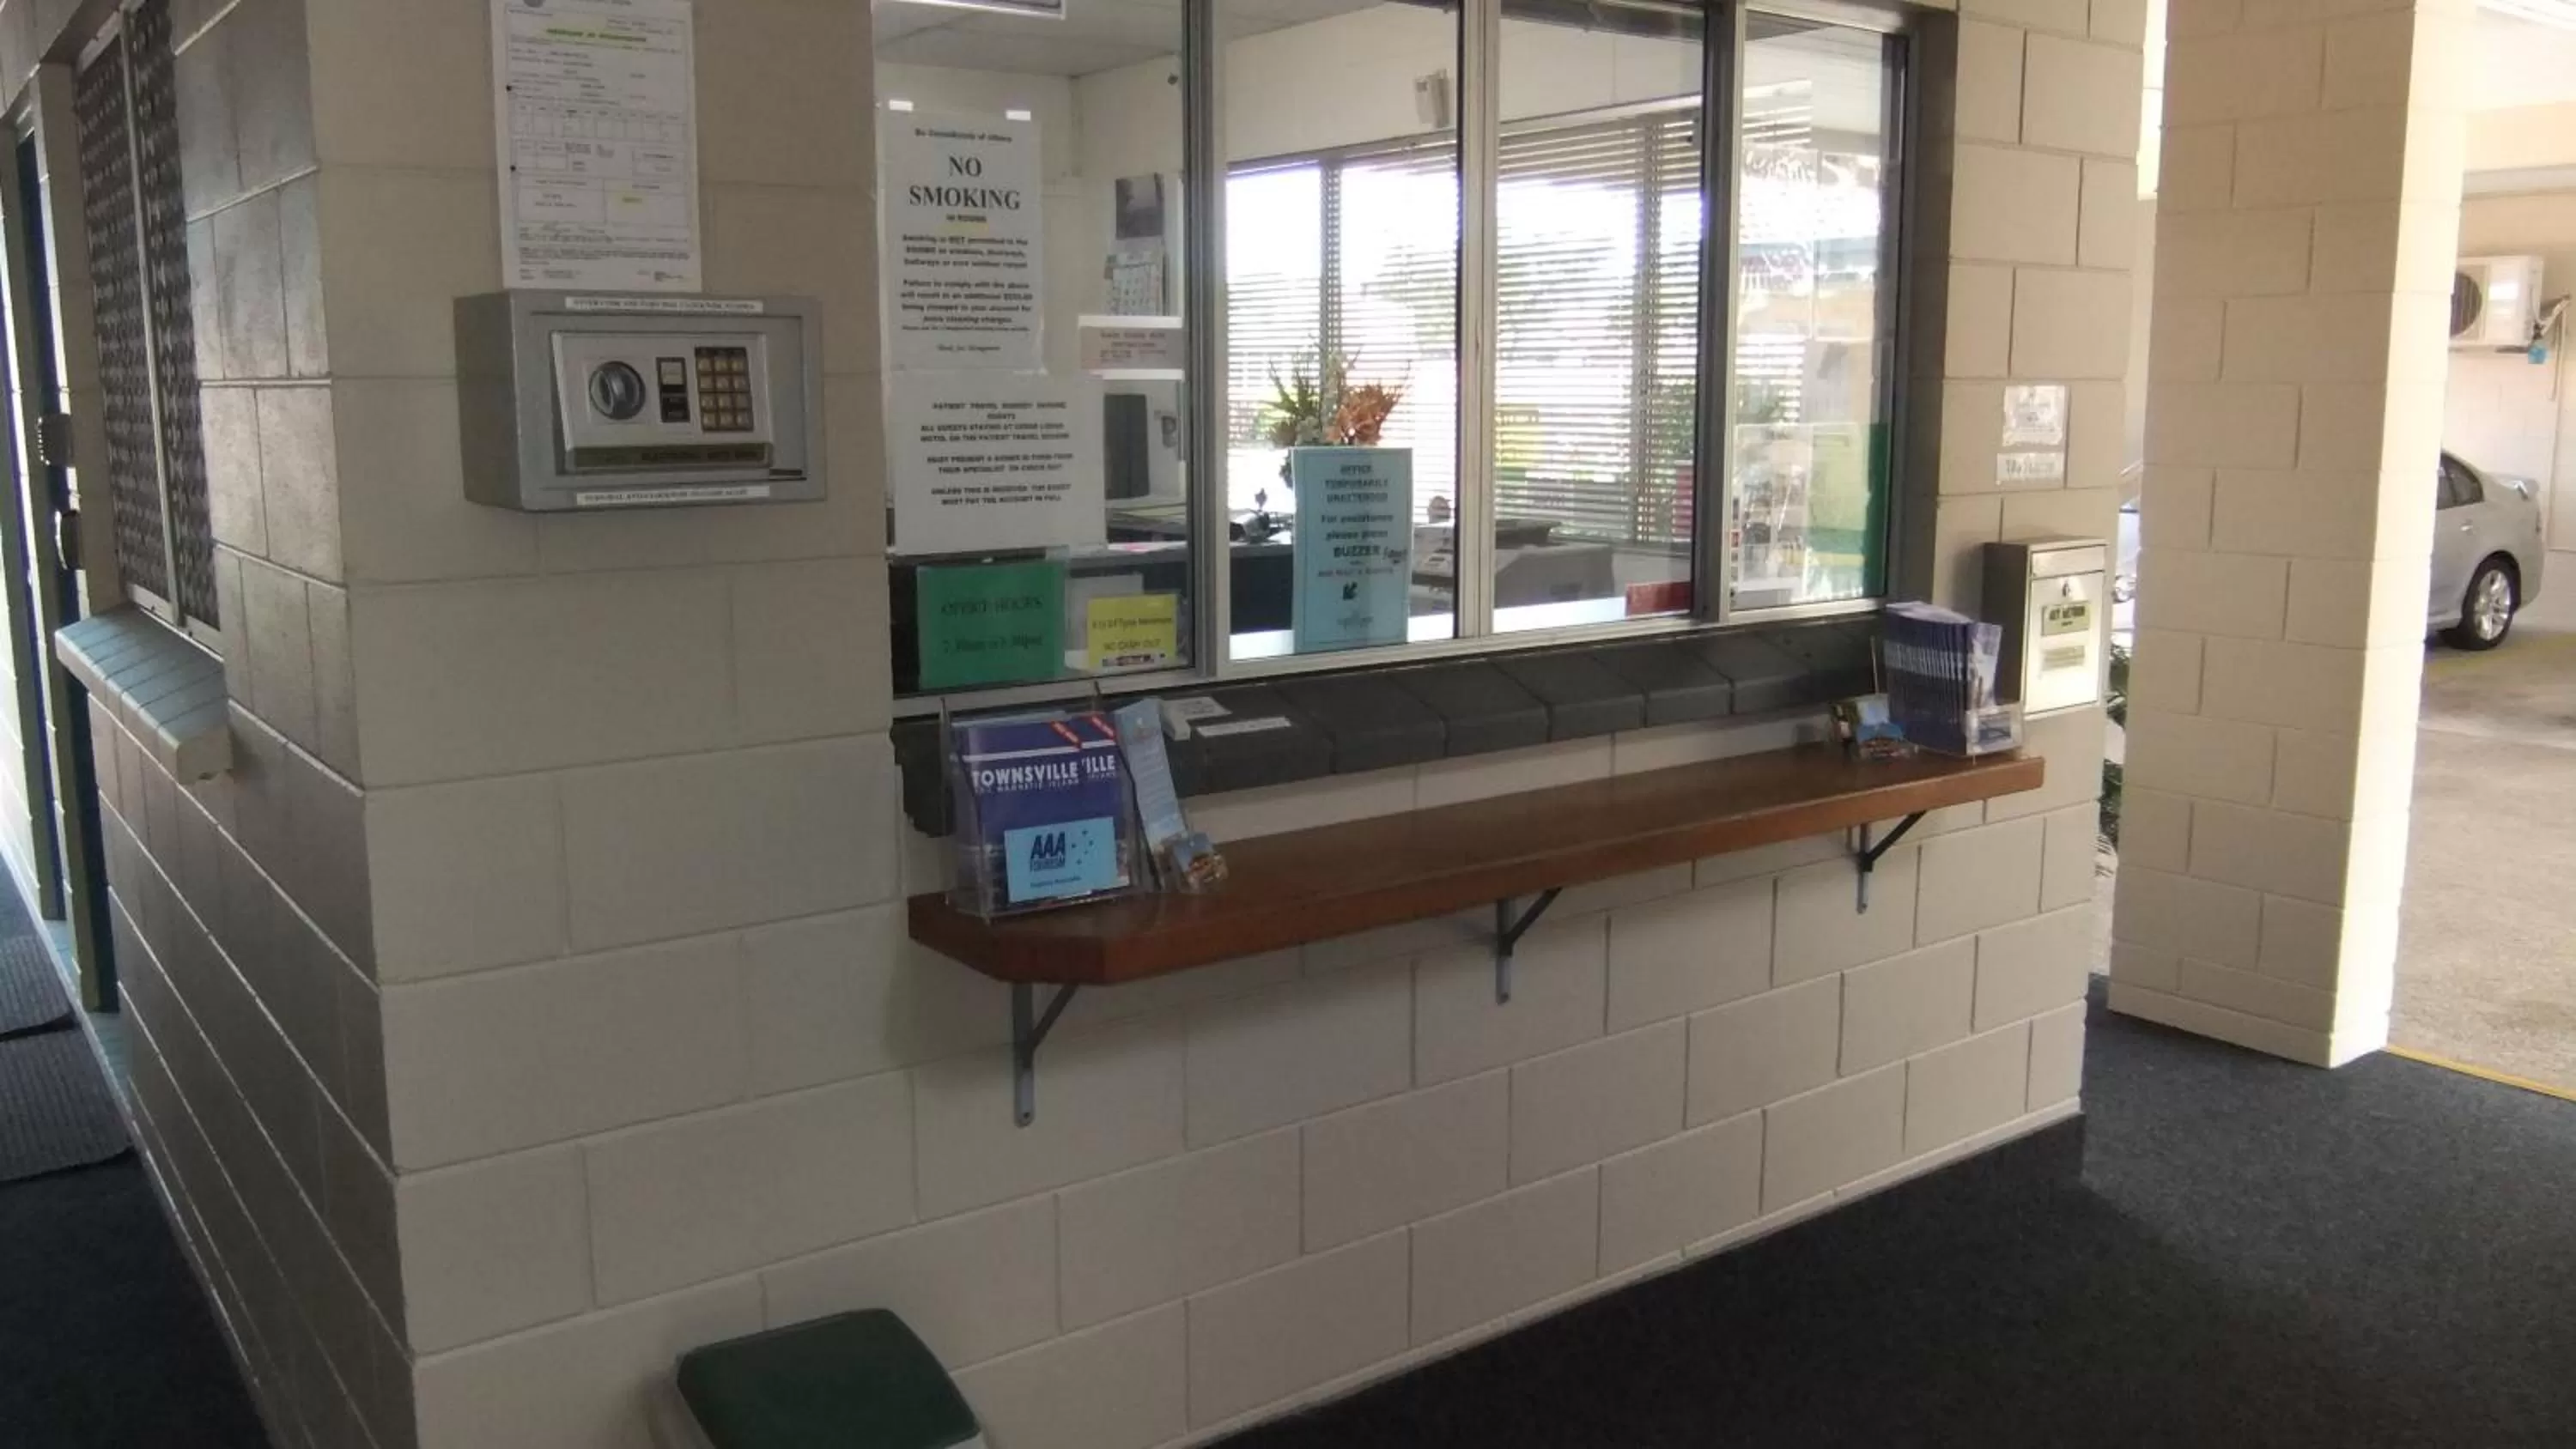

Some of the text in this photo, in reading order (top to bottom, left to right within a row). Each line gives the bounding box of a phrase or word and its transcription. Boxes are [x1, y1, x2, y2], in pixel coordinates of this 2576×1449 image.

[949, 155, 982, 177] NO
[908, 185, 1021, 210] SMOKING
[972, 761, 1079, 786] TOWNSVILLE
[1030, 831, 1066, 859] AAA
